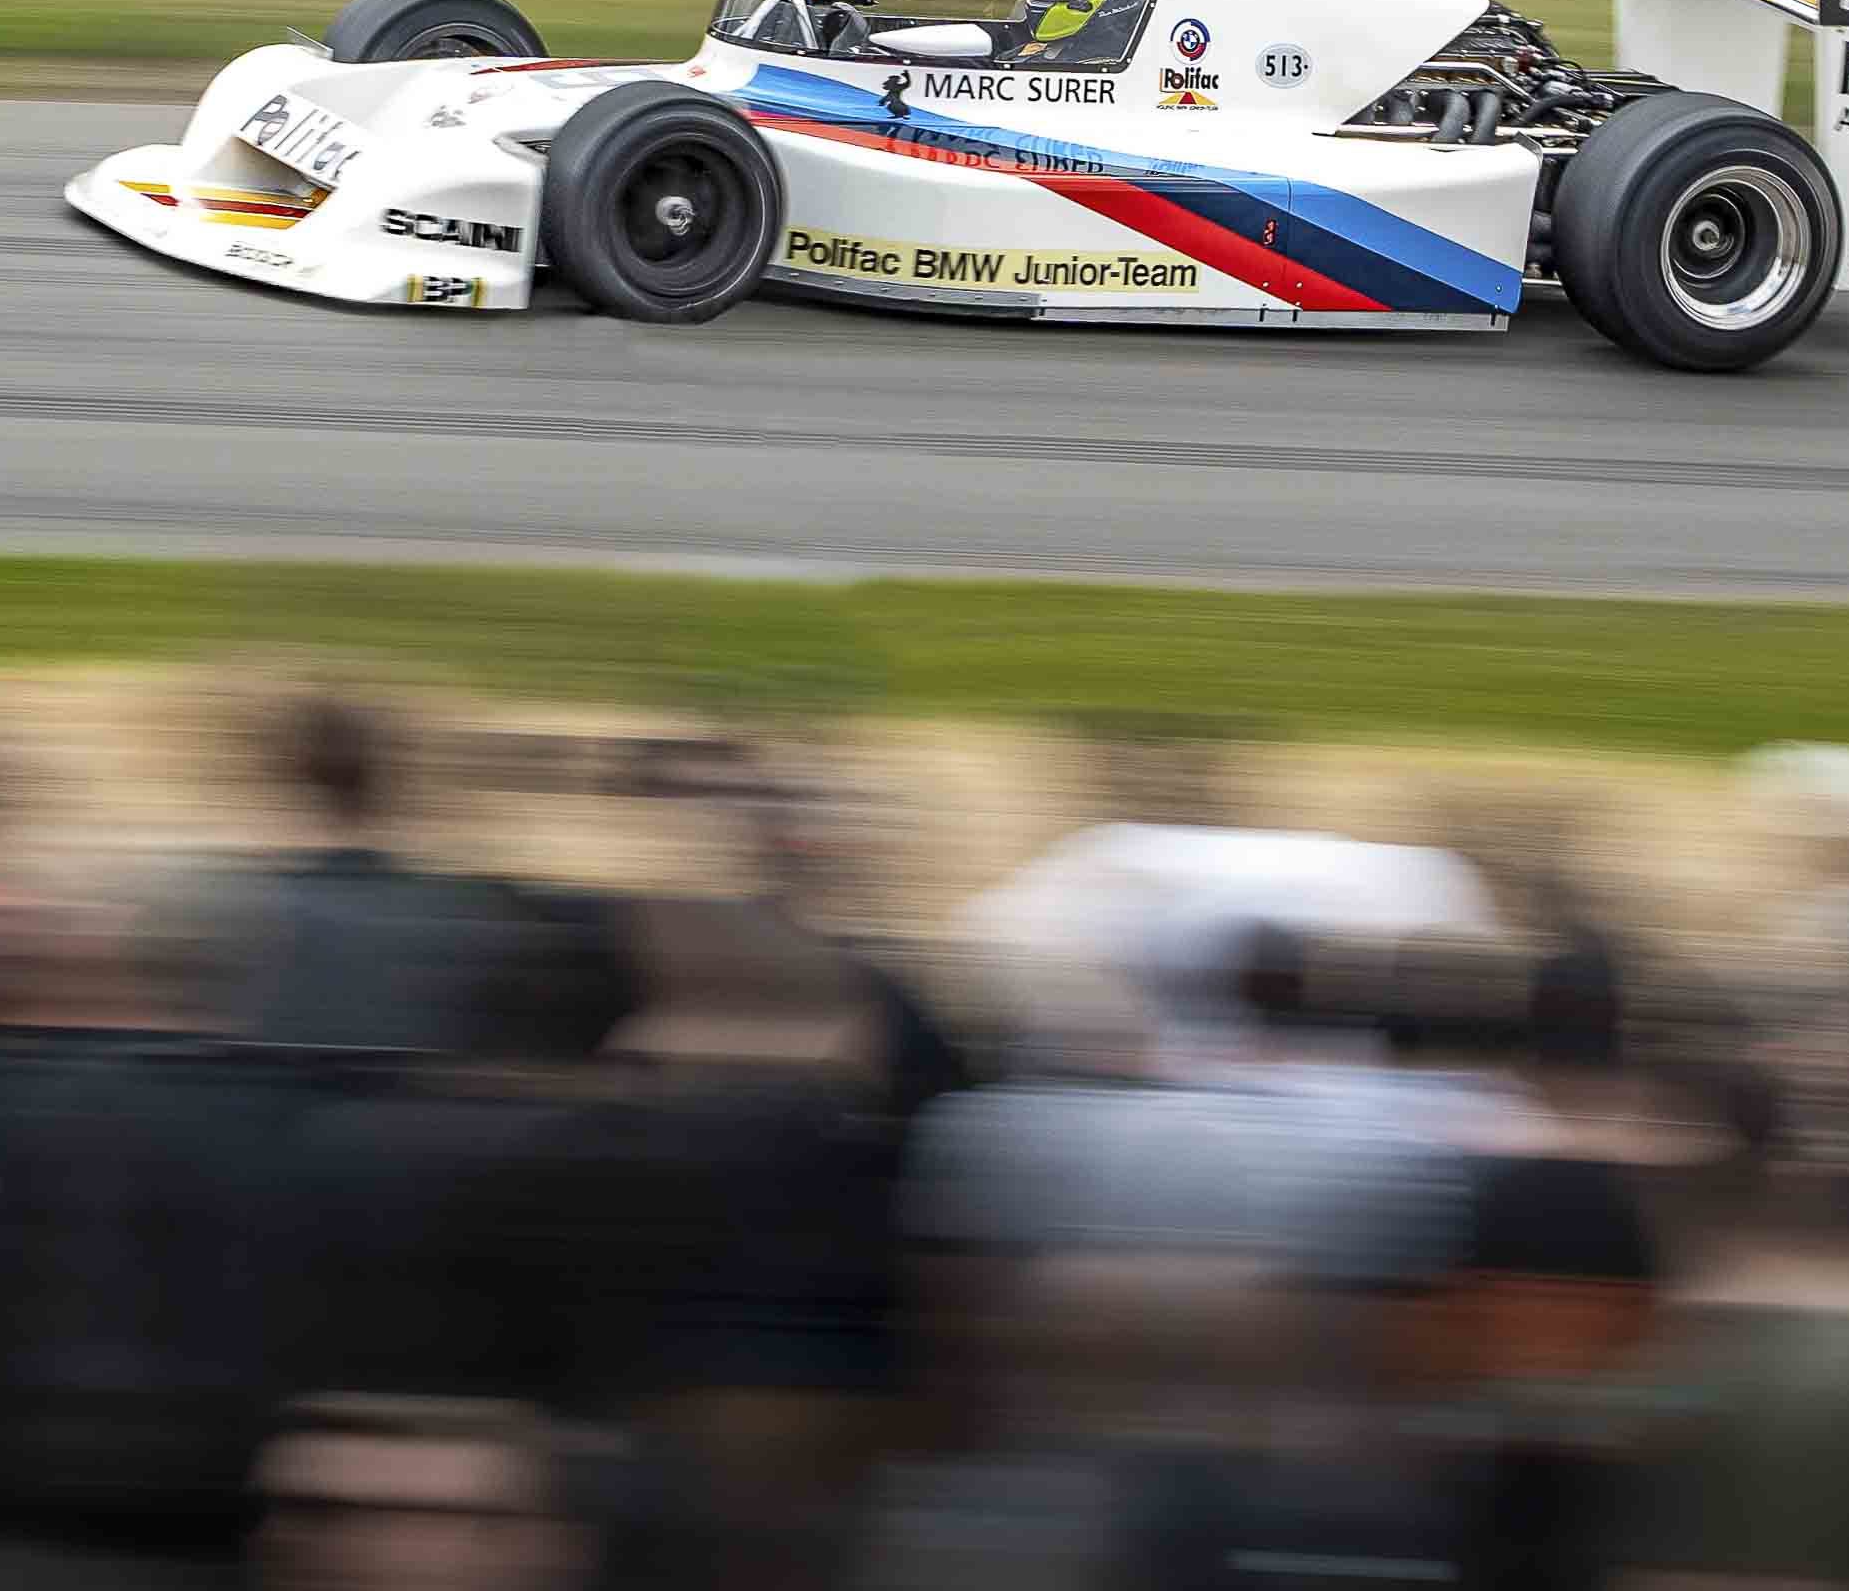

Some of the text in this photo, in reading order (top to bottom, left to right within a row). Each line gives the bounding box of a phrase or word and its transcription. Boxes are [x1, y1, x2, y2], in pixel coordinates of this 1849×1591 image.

[924, 73, 1115, 104] MARC SURER
[1164, 67, 1219, 90] Polifac
[785, 231, 1198, 288] Polifac BMW Junior-Team
[423, 276, 473, 303] BP
